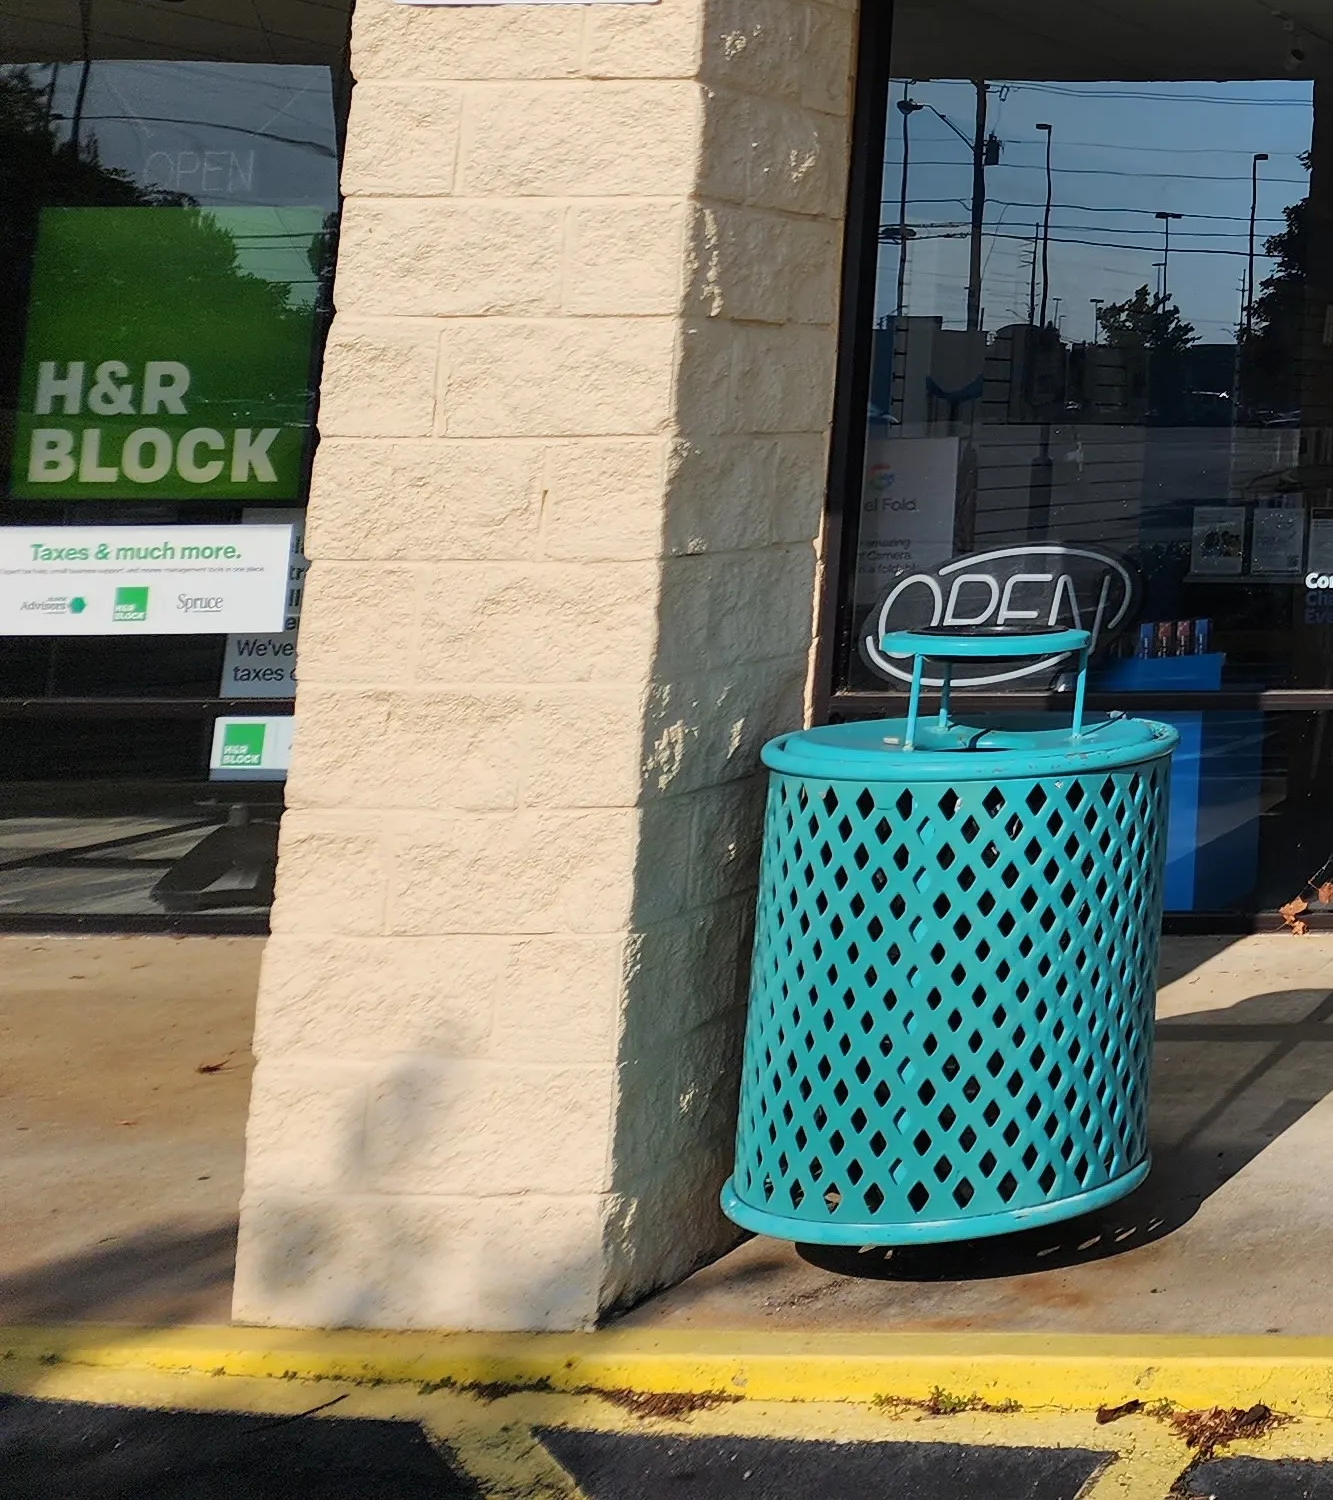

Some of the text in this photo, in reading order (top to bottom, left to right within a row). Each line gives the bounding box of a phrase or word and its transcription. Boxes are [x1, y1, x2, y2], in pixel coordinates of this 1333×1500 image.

[143, 151, 255, 192] OPEN
[33, 360, 191, 415] H&R
[27, 427, 281, 484] BLOCK
[30, 542, 242, 561] Taxes & much more.
[176, 593, 224, 613] Spruce
[878, 573, 1110, 659] OPEN
[236, 638, 294, 658] We've
[233, 666, 284, 682] taxes
[222, 754, 260, 764] BLOCK
